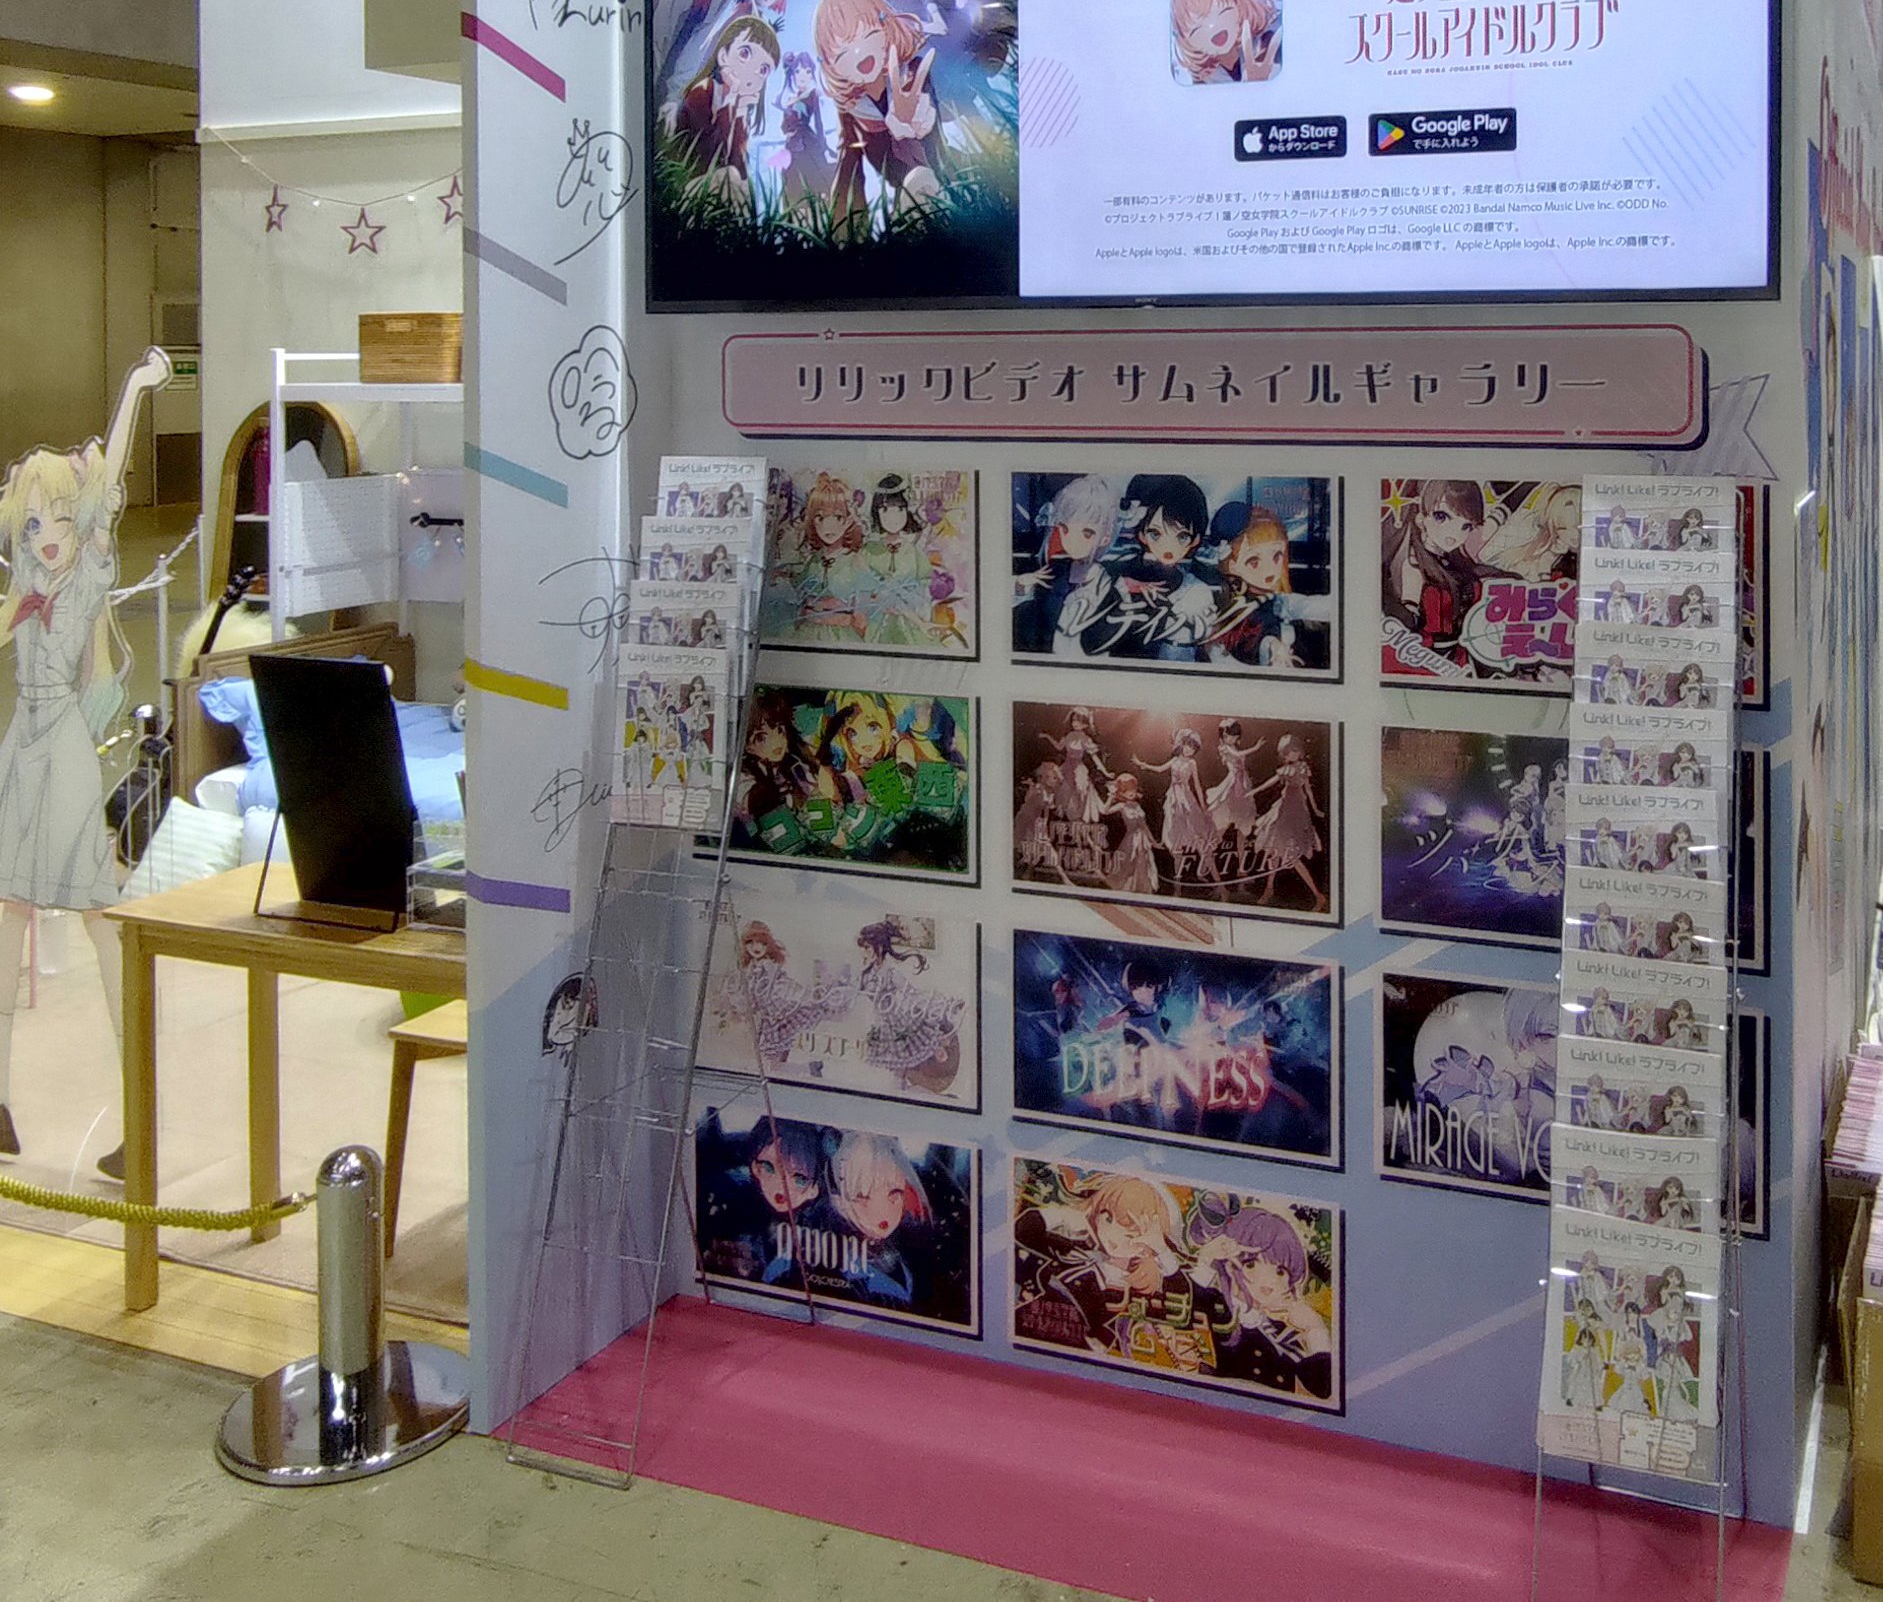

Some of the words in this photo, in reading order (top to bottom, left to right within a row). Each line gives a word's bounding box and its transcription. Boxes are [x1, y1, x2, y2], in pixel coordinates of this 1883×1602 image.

[1268, 125, 1297, 142] App
[1300, 124, 1338, 140] Store
[1412, 116, 1470, 136] Google
[1474, 114, 1508, 134] Play
[1268, 140, 1336, 154] からダウンロード
[1413, 136, 1480, 150] で手に入れよう
[1474, 202, 1506, 214] Bandai
[1508, 202, 1542, 213] Namco
[1545, 200, 1573, 212] Music
[1575, 200, 1596, 211] Live
[1227, 228, 1259, 240] Google
[1261, 227, 1279, 239] Play
[1312, 226, 1344, 237] Google
[1347, 225, 1365, 236] Play
[1407, 223, 1441, 236] Google
[796, 361, 1084, 405] リリックビデオ
[1112, 361, 1608, 408] サムネイルギャラリー
[1595, 484, 1624, 495] Link!
[1627, 485, 1655, 496] Like!
[1595, 558, 1624, 569] Link!
[1628, 559, 1655, 570] Like!
[1594, 630, 1623, 643] Link!
[1627, 633, 1654, 646] Like!
[1583, 712, 1613, 725] Link!
[1617, 715, 1645, 726] Like!
[1577, 960, 1608, 974] Link!
[1612, 966, 1641, 979] Like!
[1571, 1049, 1602, 1061] Link!
[1606, 1053, 1636, 1066] Like!
[1390, 1098, 1500, 1177] MIRAGE
